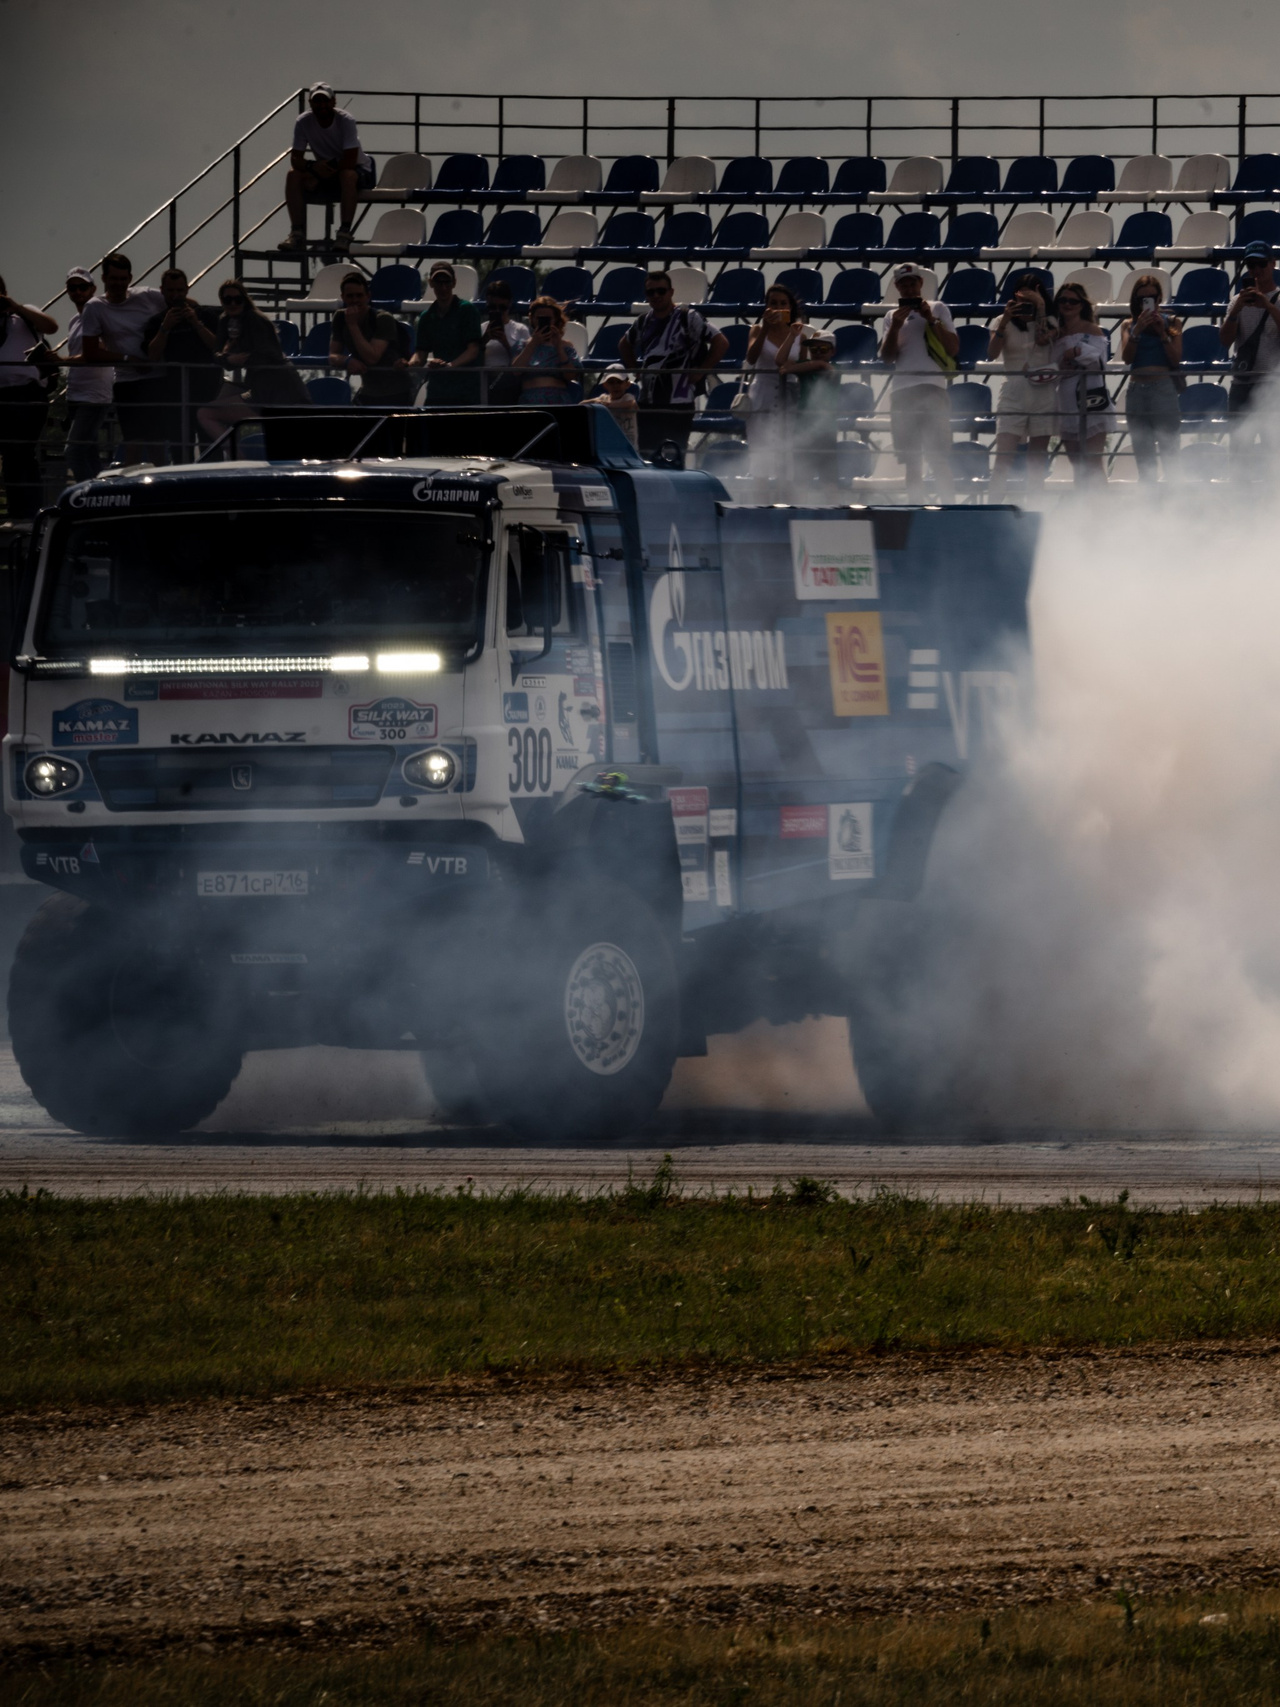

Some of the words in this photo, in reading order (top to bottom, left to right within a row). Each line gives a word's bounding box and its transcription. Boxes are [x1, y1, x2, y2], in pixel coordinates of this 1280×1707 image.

[87, 494, 131, 507] ГАЗПРОМ
[432, 490, 479, 502] ГАЗПРОМ
[811, 567, 872, 586] TATNEFT
[691, 631, 789, 690] ГАЗПРОМ
[162, 682, 229, 690] INTERNATIONAL
[231, 681, 249, 689] SILK
[251, 681, 270, 689] WAY
[357, 711, 393, 722] SILK
[396, 711, 429, 721] WAY
[59, 720, 130, 732] KAMAZ
[73, 732, 118, 743] master
[171, 732, 307, 744] KAMAZ
[380, 729, 406, 740] 300
[508, 727, 552, 793] 300
[556, 755, 579, 770] KAMAZ
[49, 857, 81, 875] VTB
[426, 857, 468, 875] VTB
[277, 873, 303, 887] 716
